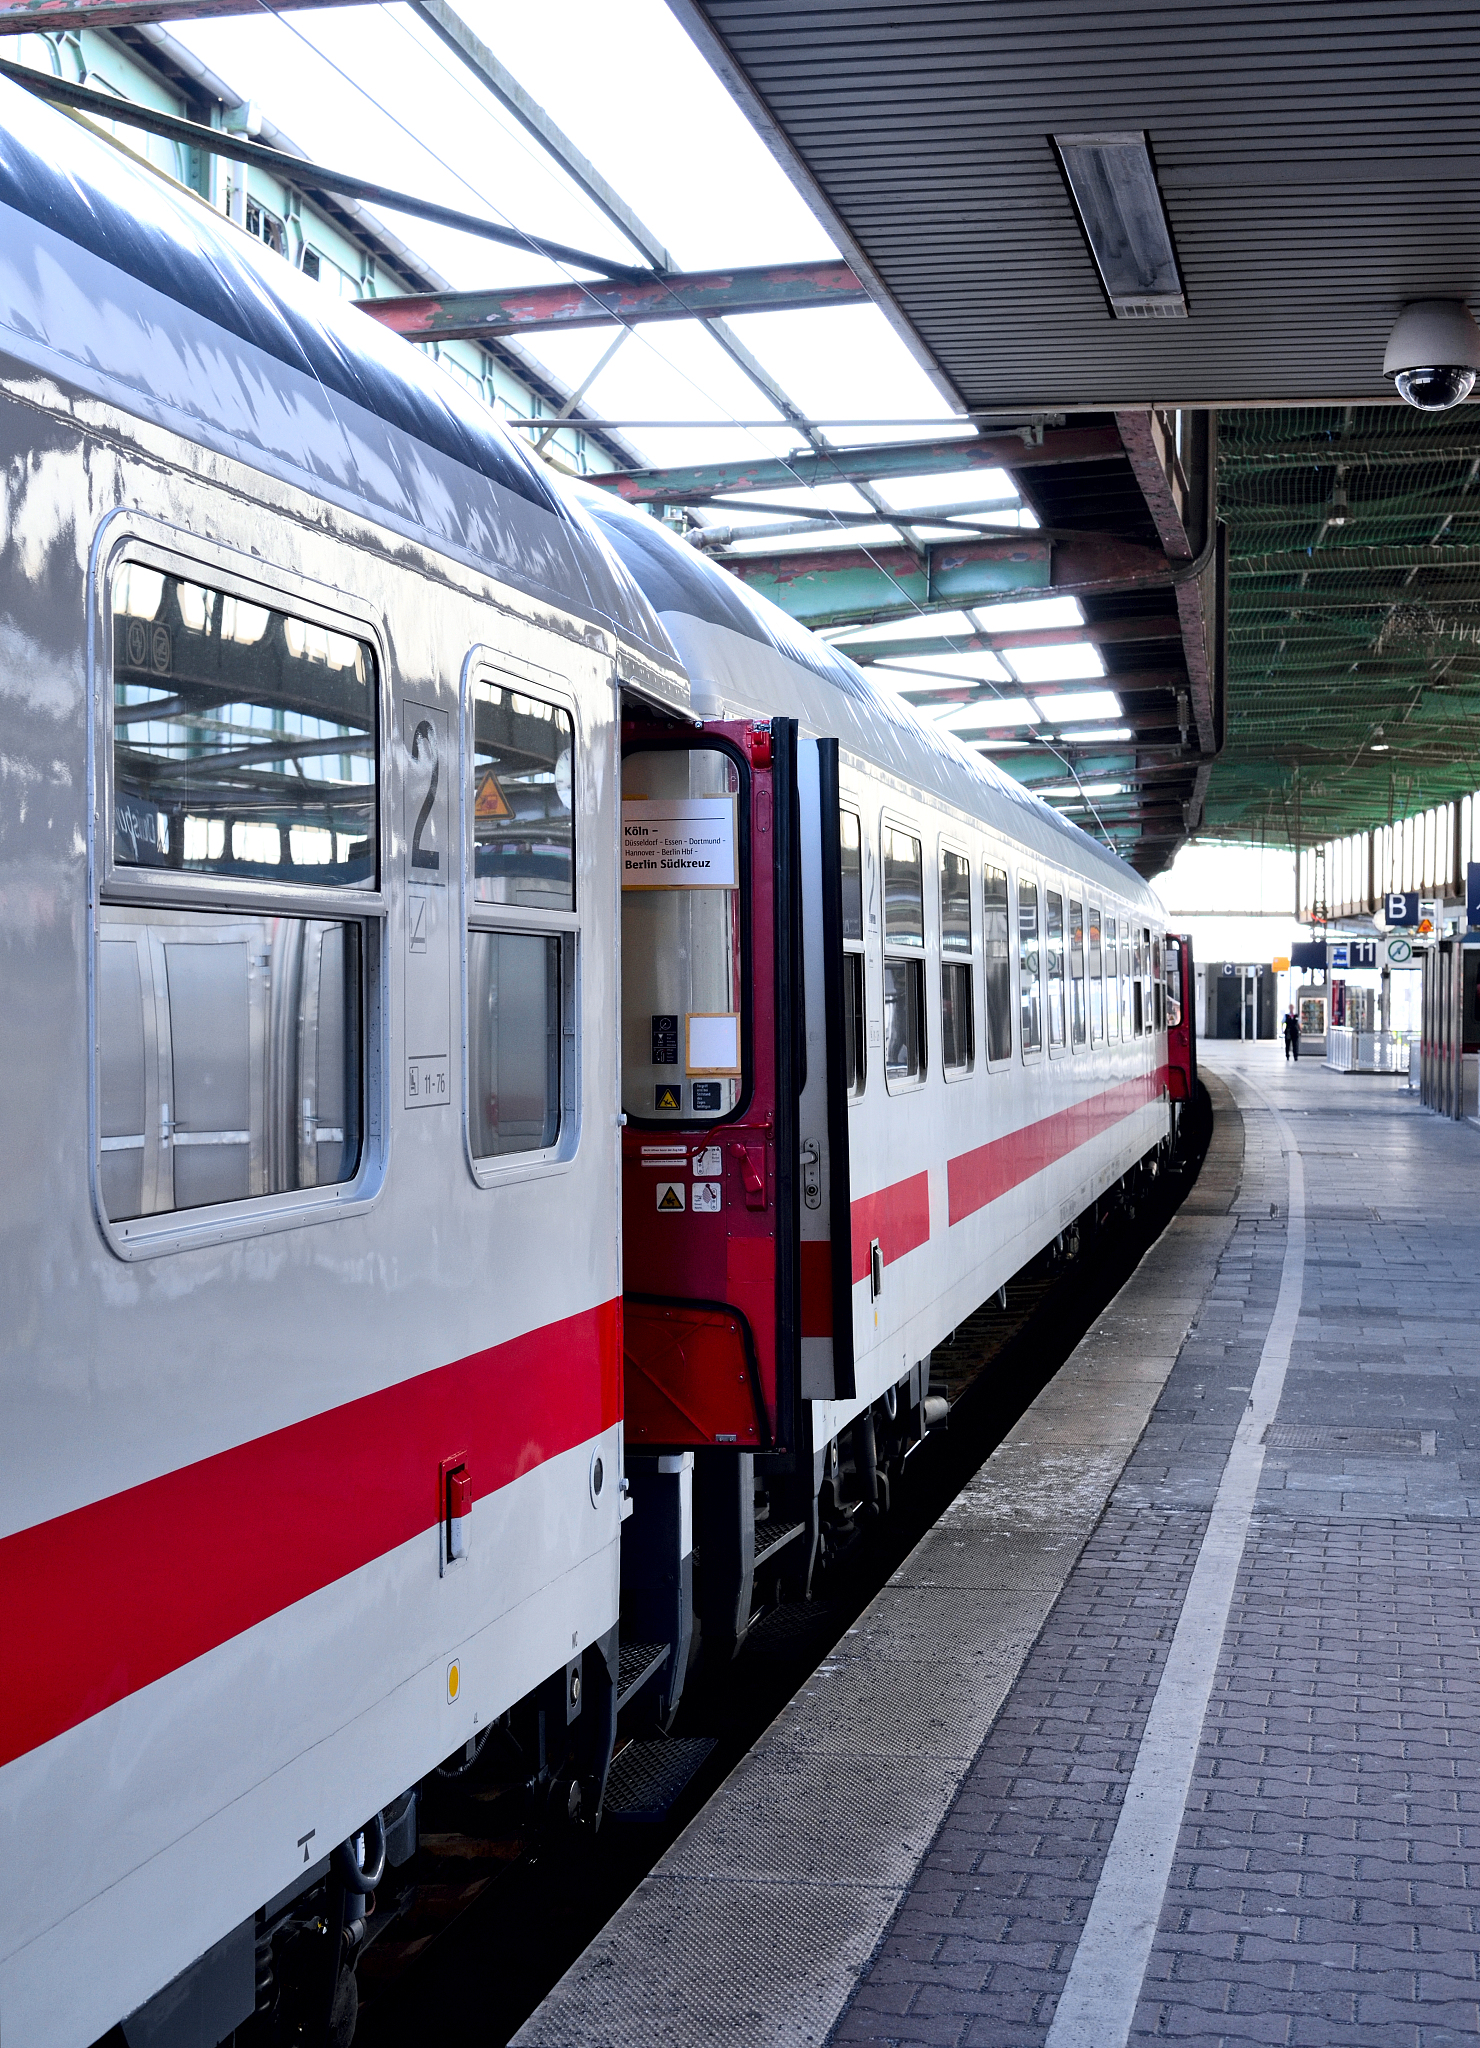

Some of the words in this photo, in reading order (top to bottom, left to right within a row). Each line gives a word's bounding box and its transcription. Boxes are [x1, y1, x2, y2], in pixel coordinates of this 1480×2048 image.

[411, 720, 440, 870] 2
[624, 826, 649, 836] Köln
[624, 838, 659, 847] Düsseldorf
[664, 838, 683, 846] Essen
[689, 837, 721, 845] Dortmund
[625, 849, 655, 857] Hannover
[661, 848, 681, 856] Berlin
[681, 847, 694, 855] Hbf
[625, 859, 657, 870] Berlin
[660, 858, 711, 869] Südkreuz
[1389, 894, 1407, 919] B
[1355, 943, 1373, 962] 11
[1223, 963, 1232, 975] C
